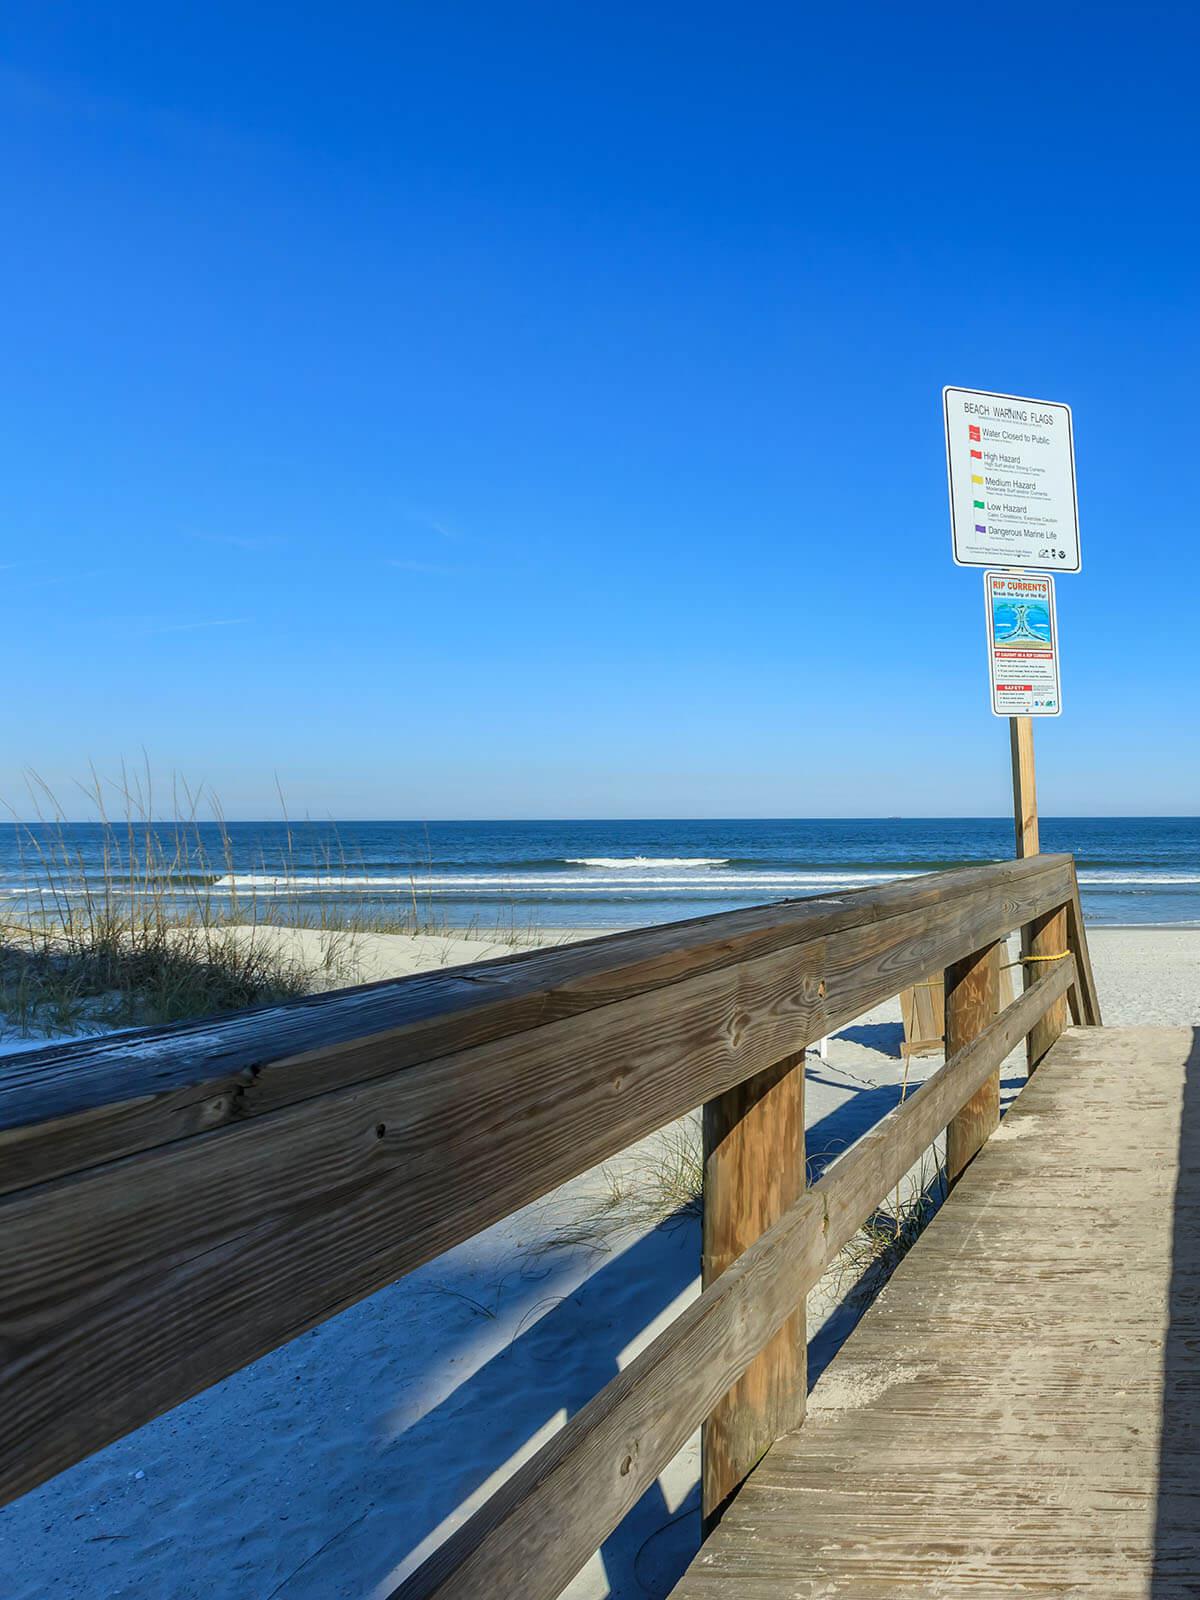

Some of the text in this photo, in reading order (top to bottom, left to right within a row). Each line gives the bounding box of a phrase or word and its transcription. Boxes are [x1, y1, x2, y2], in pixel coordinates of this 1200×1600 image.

[964, 402, 990, 416] BEACH
[993, 407, 1027, 422] WARNING
[1030, 412, 1054, 426] FLAGS
[983, 428, 1000, 438] Water
[1002, 430, 1023, 441] Closed
[1024, 434, 1030, 442] to
[1032, 434, 1050, 444] Public
[984, 452, 1021, 464] High Hazard
[985, 477, 1036, 490] Medium Hazard
[987, 502, 1027, 514] Low Hazard
[989, 526, 1022, 537] Dangerous
[1024, 529, 1044, 538] Marine
[1046, 531, 1057, 540] Life
[993, 581, 1047, 592] RIP CURRENTS
